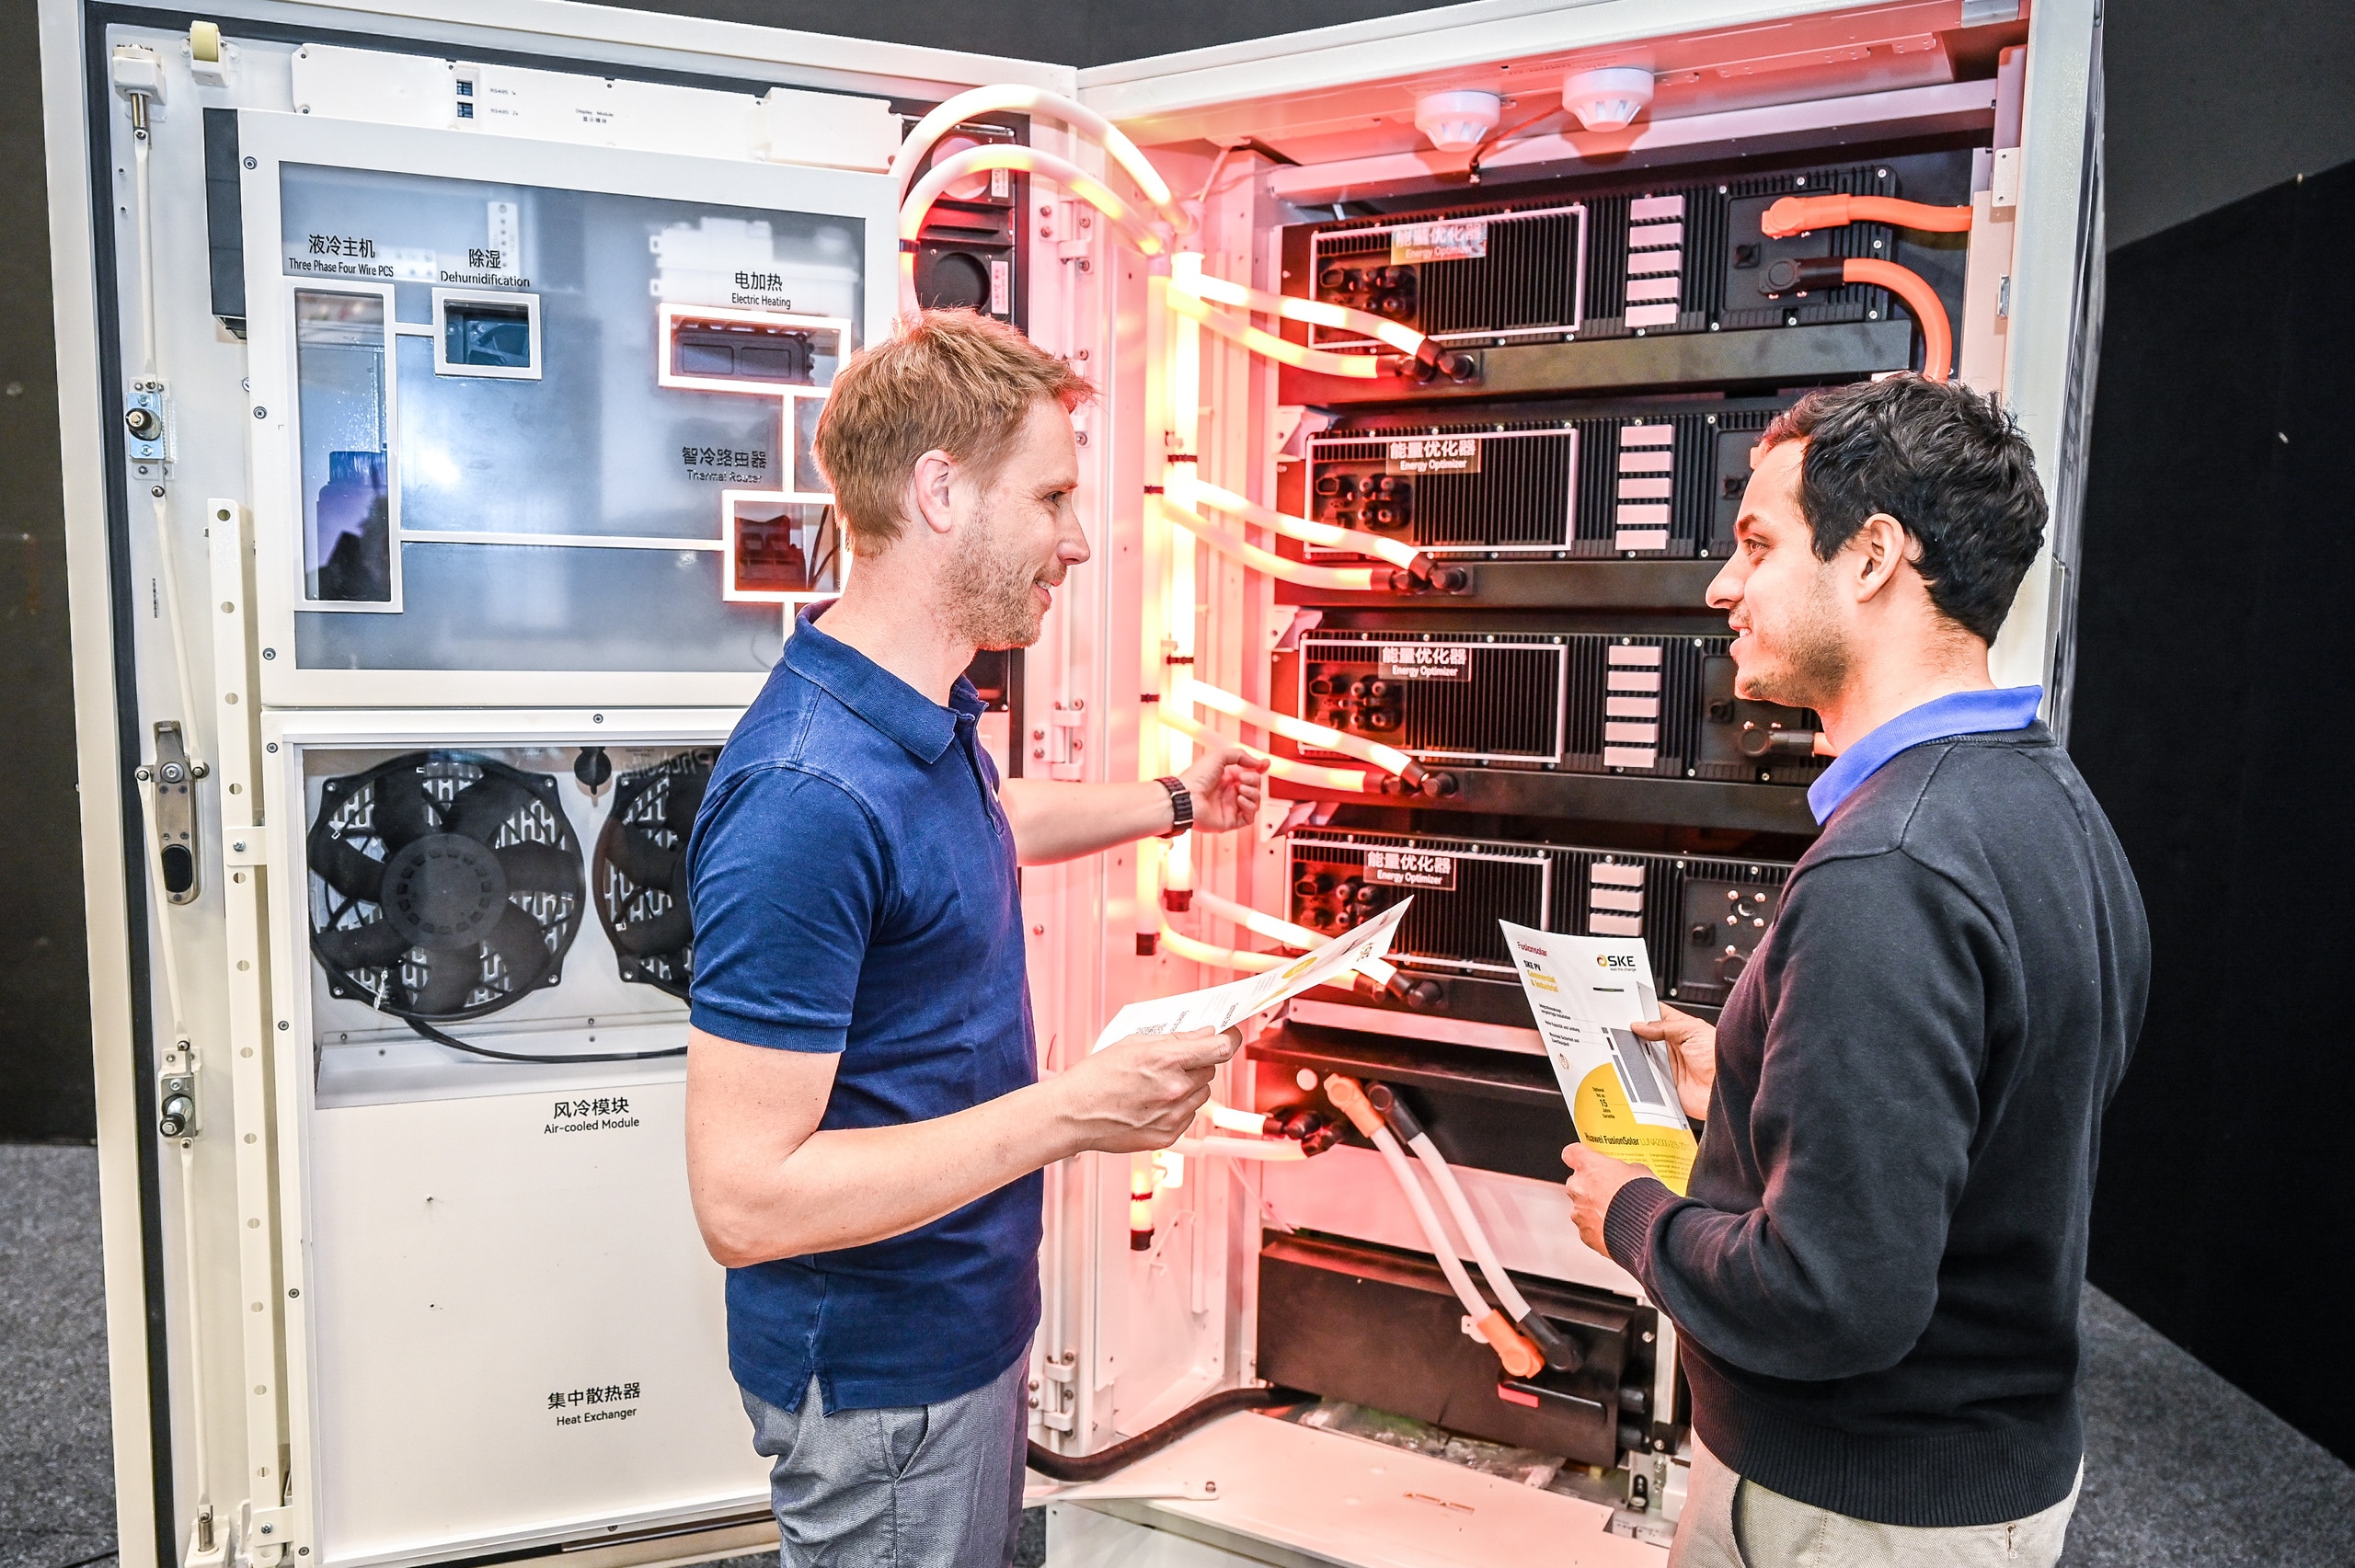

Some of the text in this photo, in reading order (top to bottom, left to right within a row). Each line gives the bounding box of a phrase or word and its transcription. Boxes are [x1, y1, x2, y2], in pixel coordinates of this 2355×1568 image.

[308, 234, 375, 258] 液冷主机
[1405, 248, 1434, 259] Energy
[289, 258, 394, 277] Three Phase Four Wire PCS
[468, 248, 501, 269] 除湿
[441, 270, 530, 287] Dehumidification
[735, 270, 783, 292] 电加热
[732, 292, 791, 310] Electric Heating
[682, 446, 767, 469] 智冷路由器
[1390, 439, 1476, 460] 能量优化器
[1400, 458, 1467, 472] Energy Optimizer
[686, 469, 727, 482] Thermal
[1382, 647, 1467, 665] 能量优化器
[1392, 664, 1458, 678] Energy Optimizer
[1367, 851, 1452, 875] 能量优化器
[1377, 869, 1442, 885] Energy Optimizer
[1523, 959, 1534, 969] SKE
[1607, 956, 1636, 967] SKE
[553, 1096, 629, 1119] 风冷模块
[1600, 1099, 1608, 1107] 15
[544, 1116, 640, 1134] Air-cooled Module
[1584, 1132, 1603, 1143] Huawei
[1603, 1136, 1639, 1146] FusionSolar
[547, 1382, 641, 1410] 集中散热器
[557, 1408, 638, 1426] Heat Exchanger
